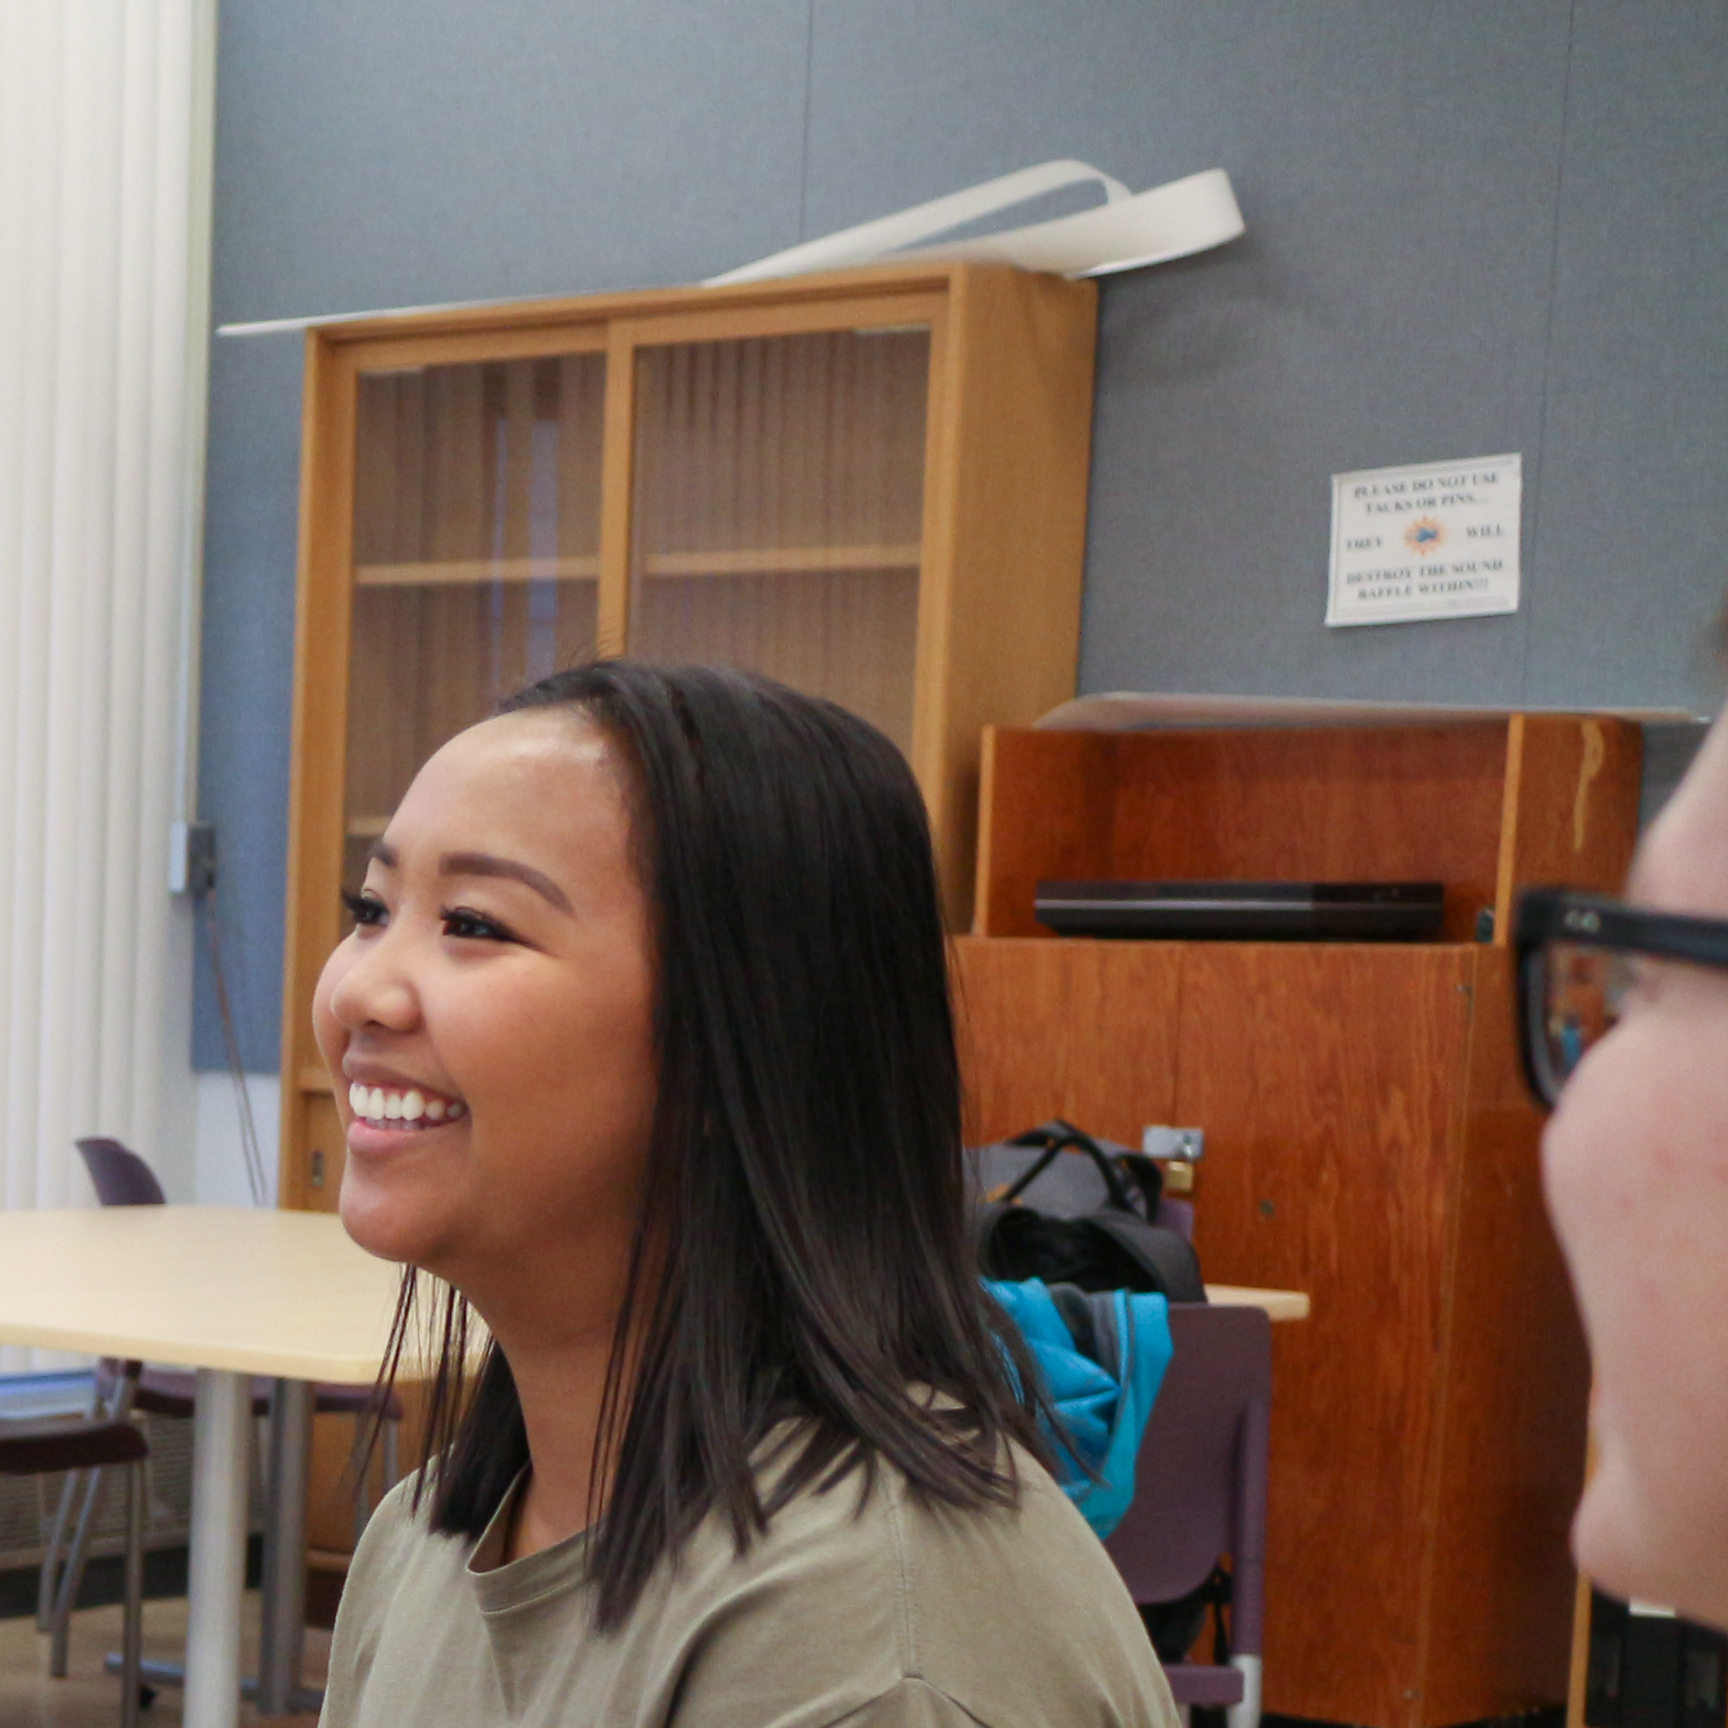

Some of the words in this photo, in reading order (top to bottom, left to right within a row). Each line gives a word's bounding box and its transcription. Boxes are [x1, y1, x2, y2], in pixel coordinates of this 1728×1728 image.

[1354, 481, 1407, 498] PLEASE
[1412, 478, 1434, 492] DO
[1438, 474, 1467, 488] NOT
[1471, 470, 1499, 484] USE
[1366, 498, 1412, 513] TACKS
[1417, 496, 1437, 508] OR
[1347, 537, 1382, 549] THEY
[1466, 524, 1503, 537] WILL
[1347, 570, 1412, 584] DESTROY
[1418, 565, 1447, 577] THE
[1452, 559, 1504, 574] SOUND
[1357, 585, 1412, 600] BAFFLE
